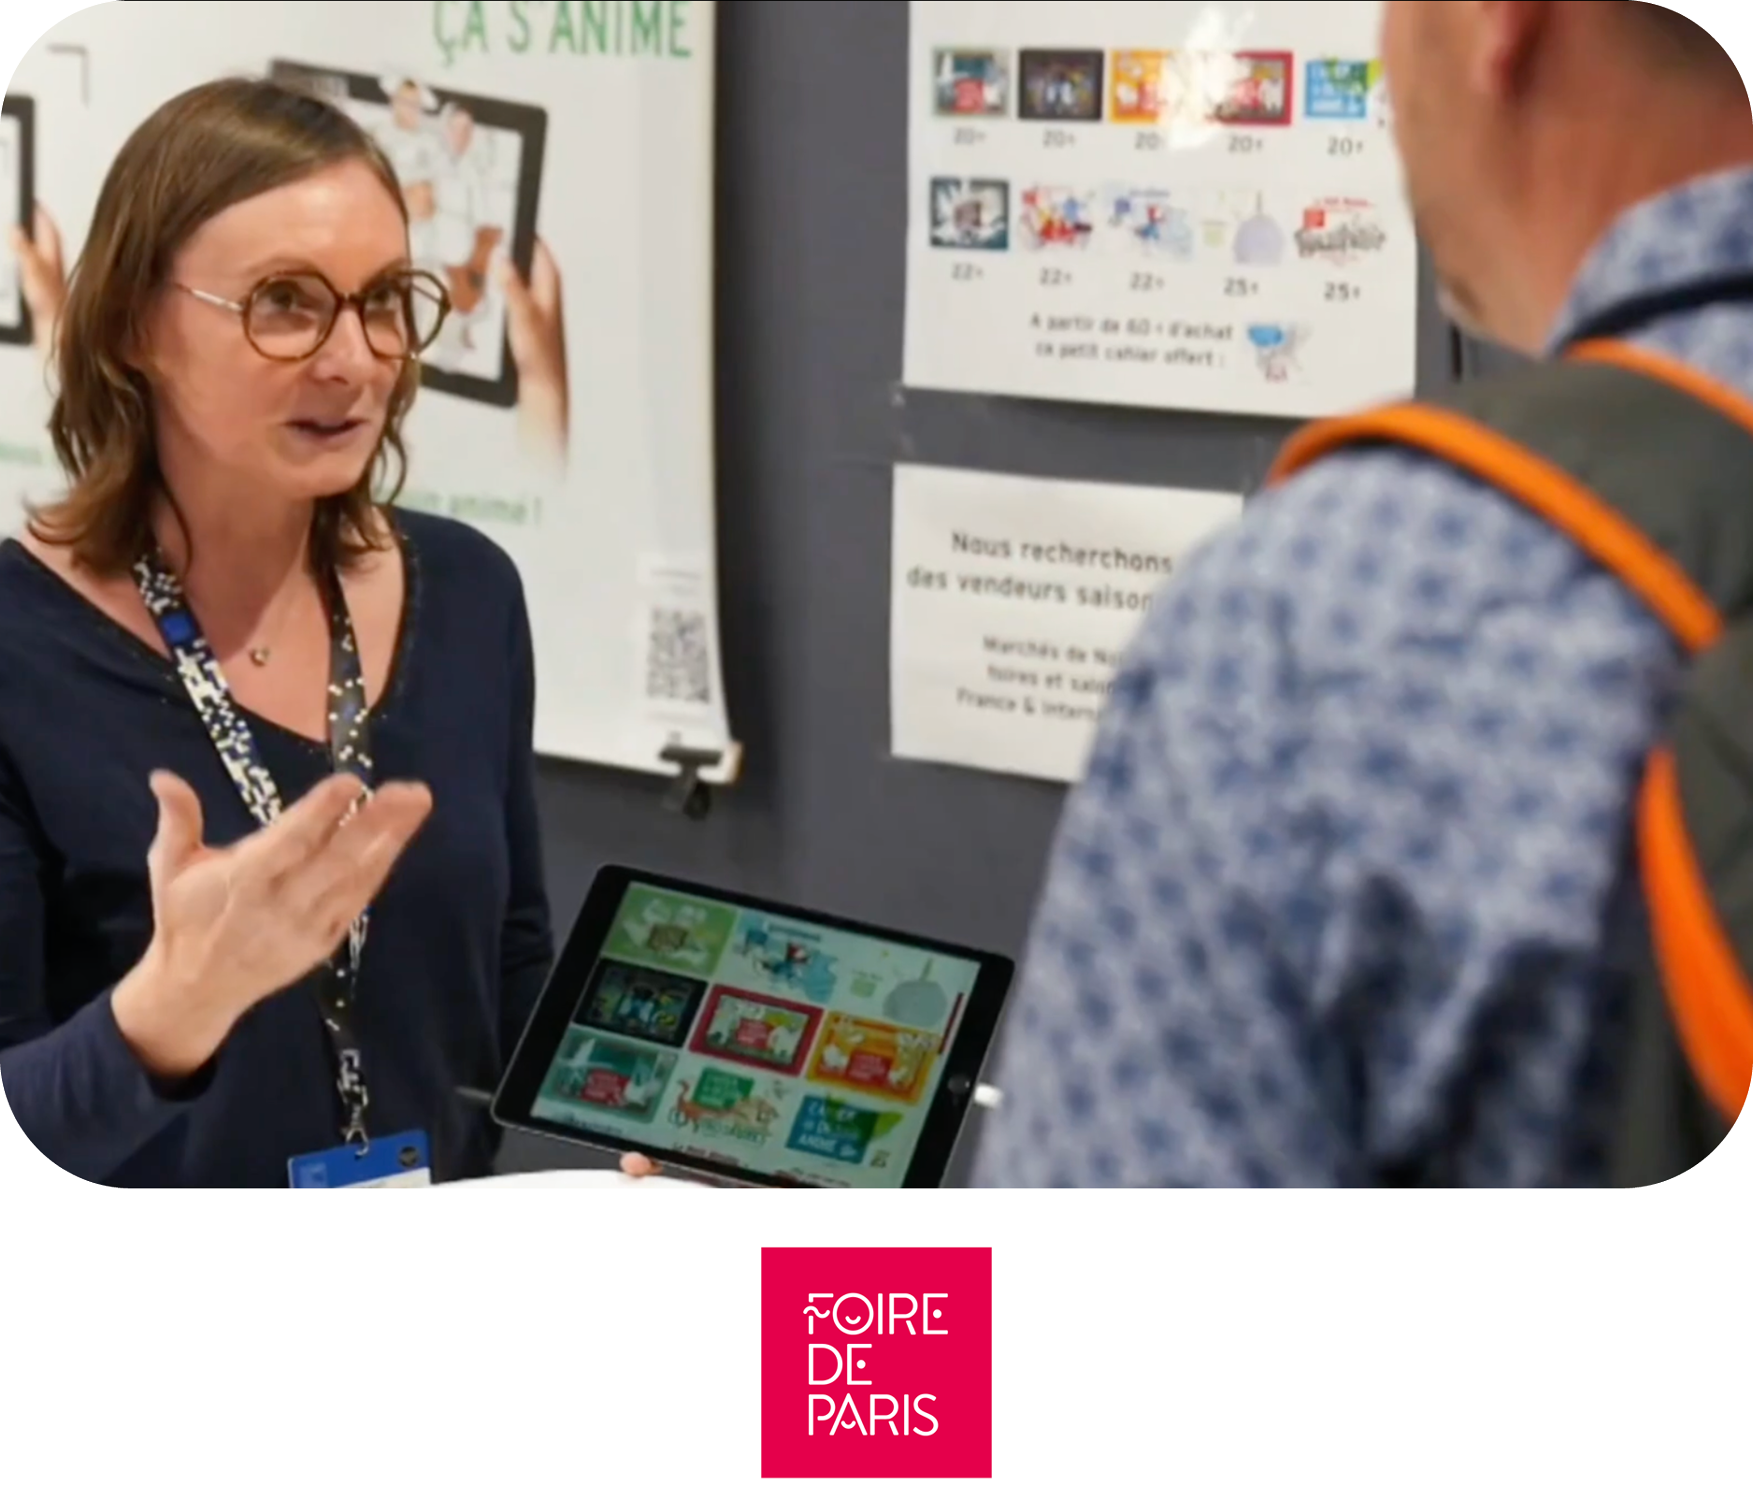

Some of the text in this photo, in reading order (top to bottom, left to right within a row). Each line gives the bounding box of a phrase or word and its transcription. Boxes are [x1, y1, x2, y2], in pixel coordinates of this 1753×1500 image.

[506, 1, 693, 58] SANIME
[951, 532, 1173, 574] Nous recherchons
[906, 565, 947, 589] des
[957, 571, 1066, 604] vendeurs
